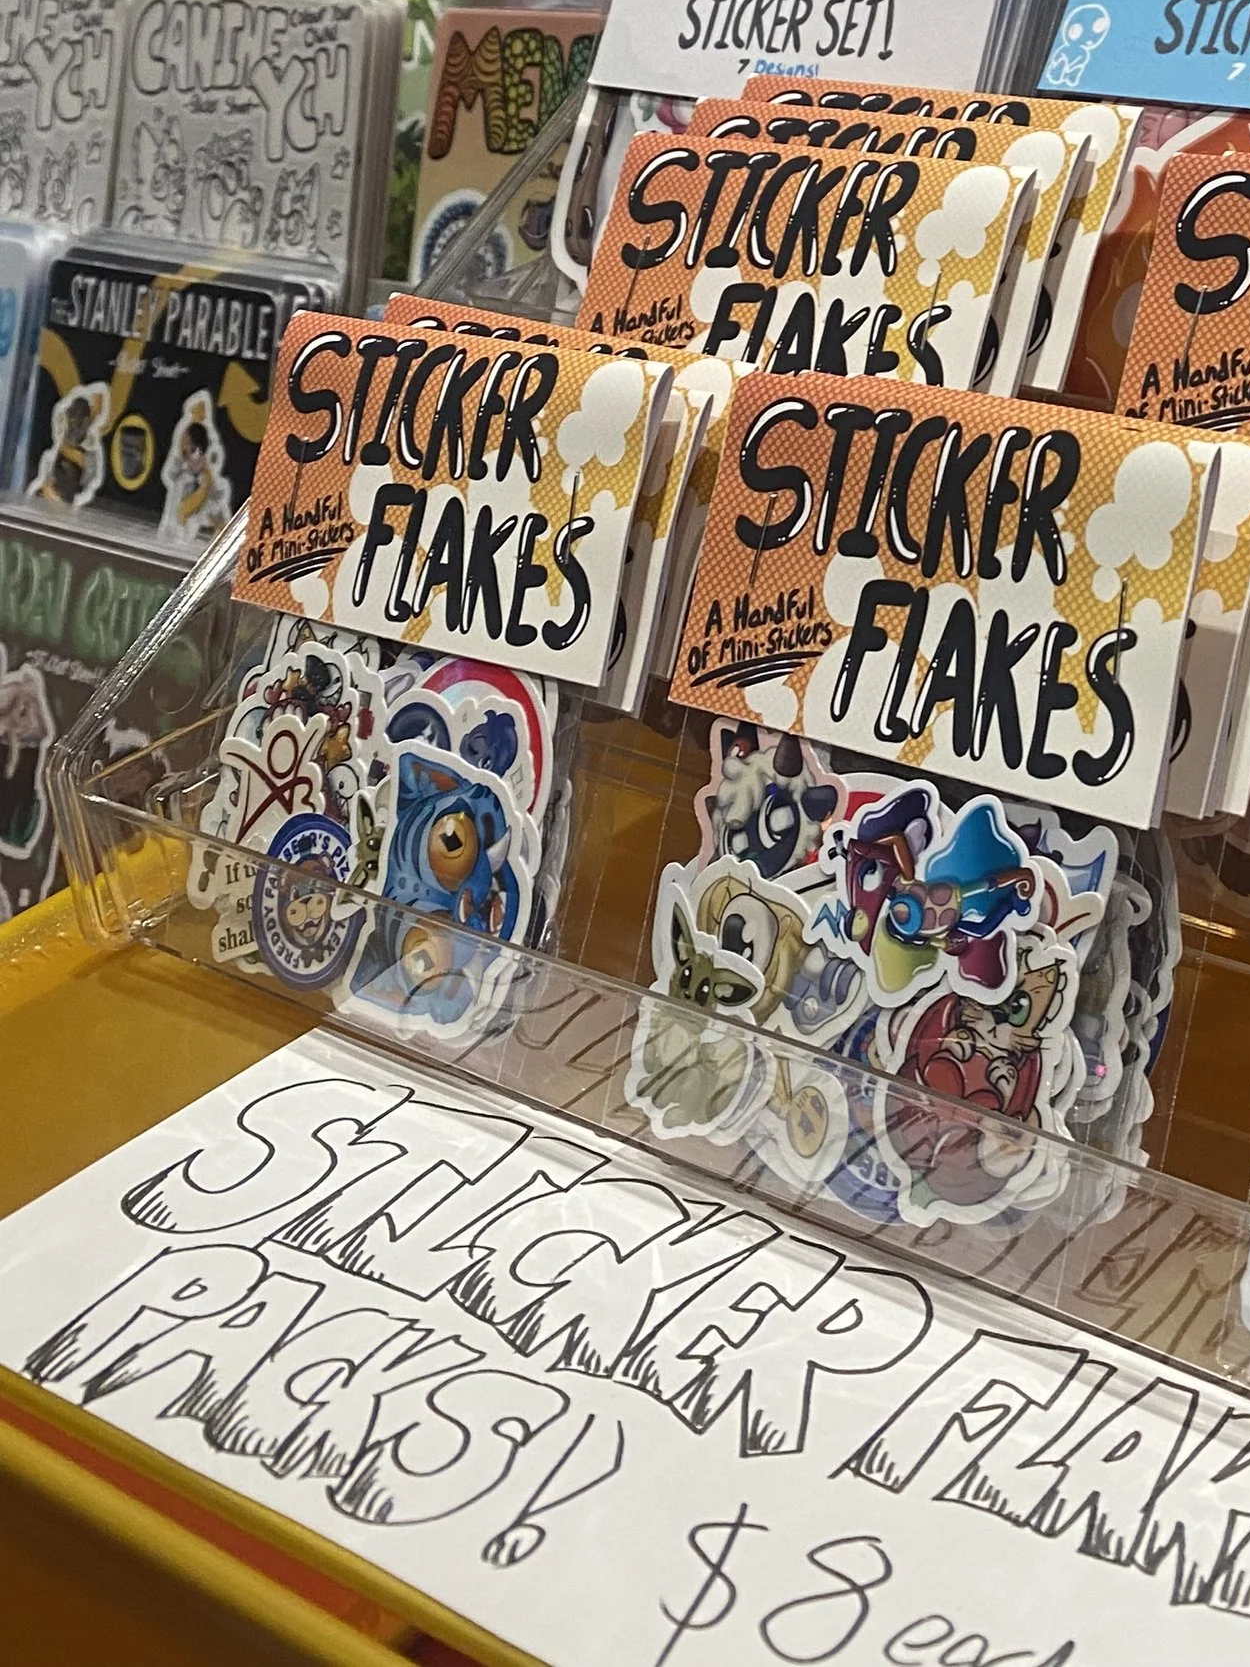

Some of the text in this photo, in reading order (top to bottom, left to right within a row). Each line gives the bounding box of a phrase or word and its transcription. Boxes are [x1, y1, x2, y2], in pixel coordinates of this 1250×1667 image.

[249, 43, 350, 163] YCH
[737, 58, 750, 74] 7
[1226, 62, 1242, 82] 7
[621, 146, 921, 281] STICKER
[68, 273, 161, 339] STANLEY
[165, 288, 272, 361] PARABLE
[590, 293, 683, 337] A Handful
[701, 281, 953, 389] FLAKES
[285, 330, 559, 484] STICKER
[1141, 362, 1161, 401] A
[259, 490, 344, 542] A Handful
[735, 396, 1082, 587] STICKER
[351, 482, 596, 652] FLAKES
[705, 587, 815, 635] A Handful
[829, 578, 1138, 788] FLAKES
[121, 1077, 934, 1459] STICKER
[23, 1242, 627, 1570] PACKS!
